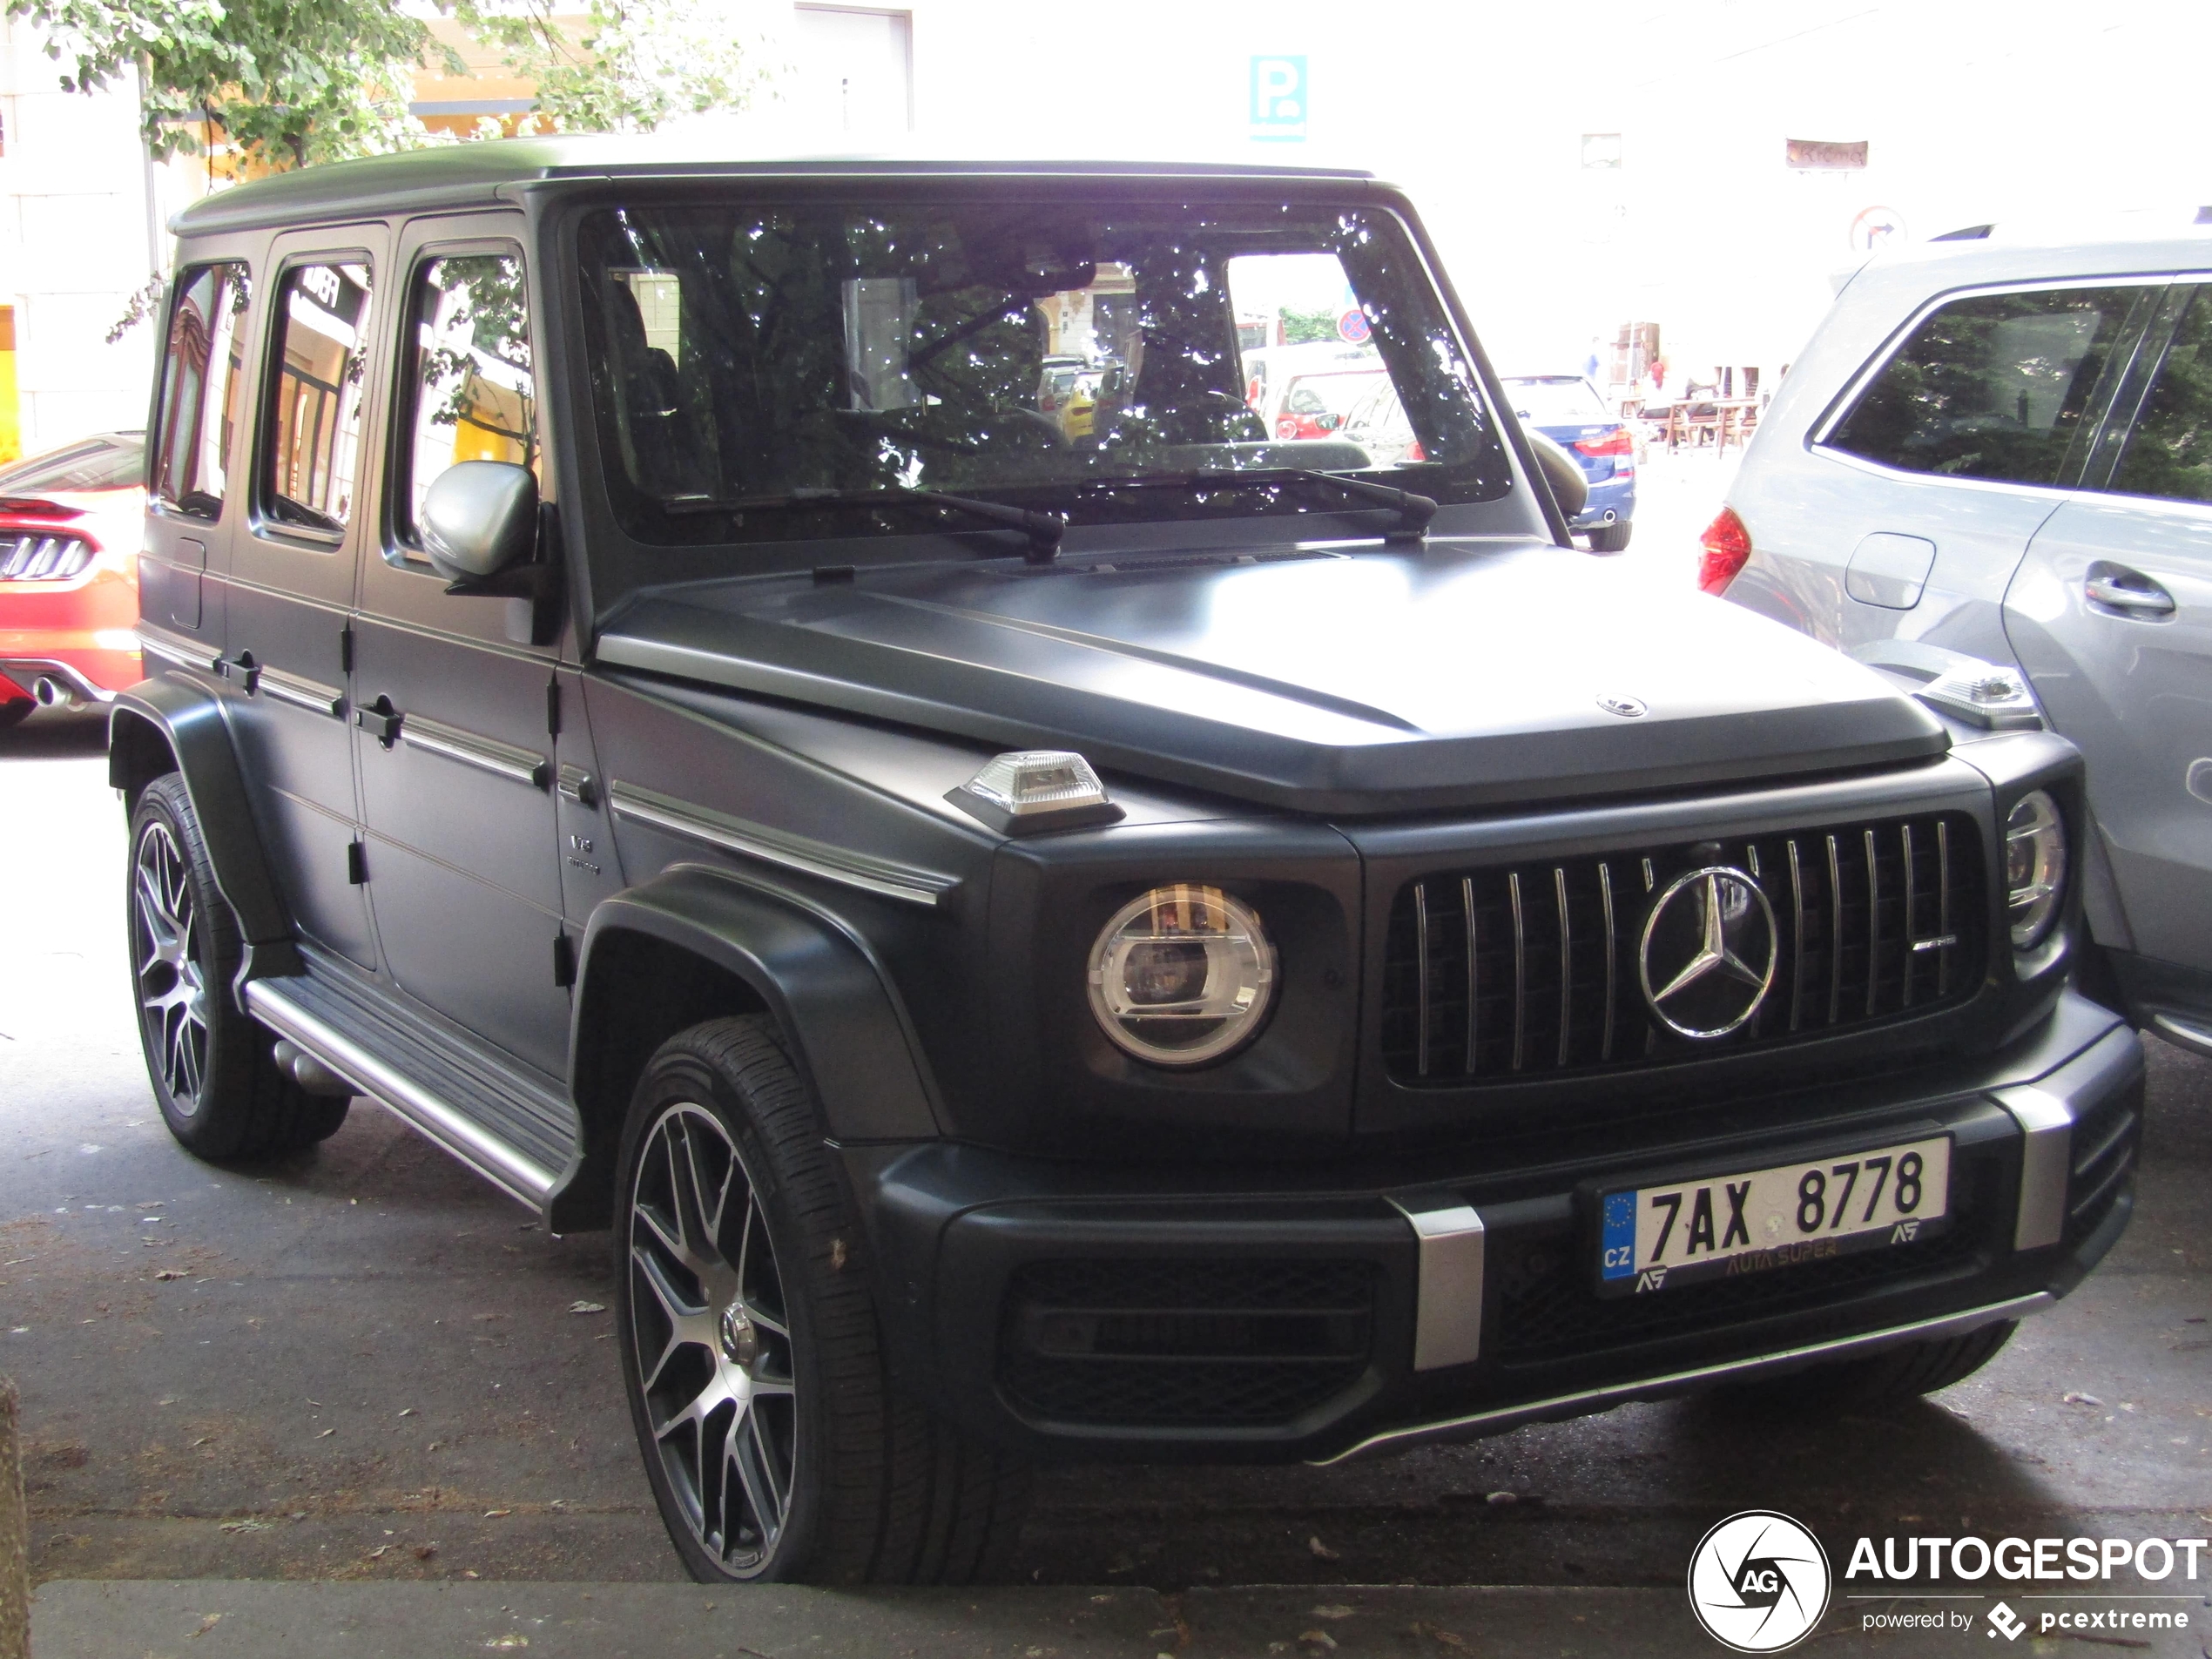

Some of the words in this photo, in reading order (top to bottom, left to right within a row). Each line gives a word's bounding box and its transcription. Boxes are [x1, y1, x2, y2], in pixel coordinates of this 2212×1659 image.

[1258, 60, 1298, 118] P
[1650, 1180, 1751, 1263] 7AX
[1797, 1151, 1923, 1233] 8778
[1604, 1245, 1631, 1268] CZ
[1726, 1252, 1772, 1277] AUTA
[1777, 1240, 1838, 1266] SUPER
